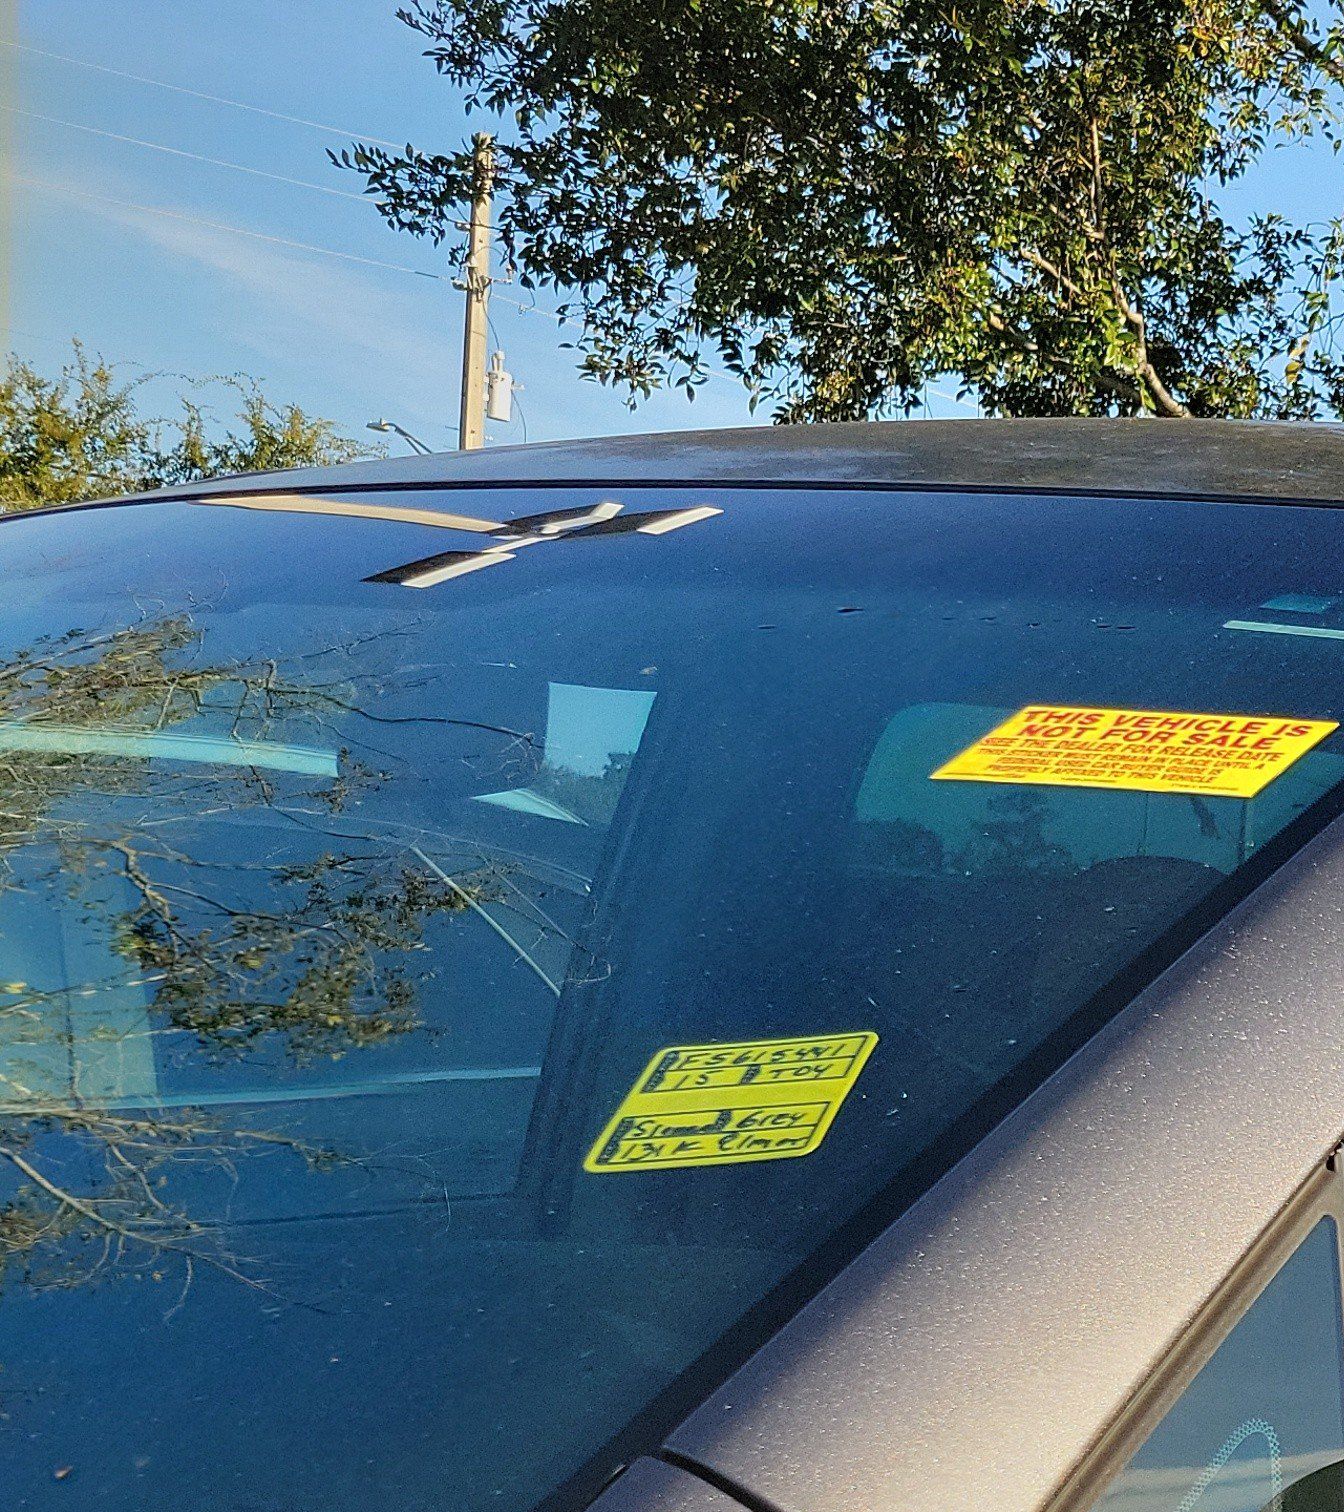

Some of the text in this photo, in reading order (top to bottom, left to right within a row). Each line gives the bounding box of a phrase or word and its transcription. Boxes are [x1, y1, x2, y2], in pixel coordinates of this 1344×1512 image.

[1025, 711, 1311, 736] THIS VEHICLE IS
[1017, 724, 1280, 749] NOT FOR SALE
[1020, 739, 1054, 748] THE
[1054, 740, 1121, 752] DEALER
[1121, 744, 1158, 754] FOR
[1158, 746, 1236, 758] RELEASE
[1237, 751, 1283, 761] DATE
[1170, 758, 1212, 766] PLACE
[1213, 761, 1249, 769] UNTIL
[1161, 774, 1215, 783] VEHICLE
